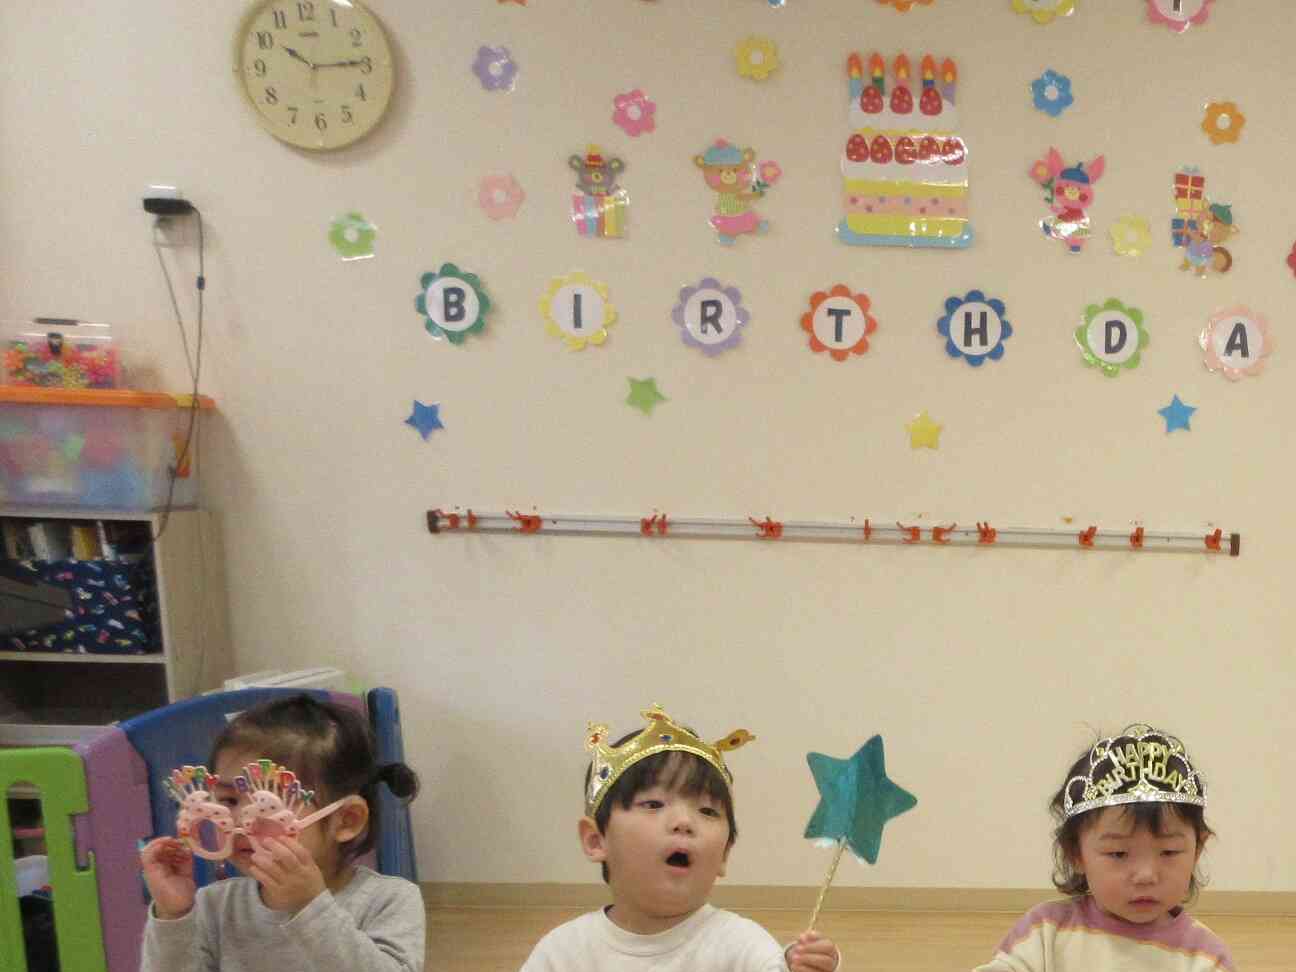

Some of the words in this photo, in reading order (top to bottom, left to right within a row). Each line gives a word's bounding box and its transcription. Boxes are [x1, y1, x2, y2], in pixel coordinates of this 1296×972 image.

[273, 10, 287, 29] 11
[297, 2, 314, 21] 12
[329, 8, 338, 28] 1
[256, 31, 274, 50] 10
[350, 28, 363, 47] 2
[254, 59, 266, 78] 9
[360, 56, 373, 74] 3
[264, 87, 278, 105] 8
[355, 83, 367, 101] 4
[288, 107, 298, 126] 7
[314, 113, 327, 131] 6
[341, 105, 352, 123] 5
[1108, 742, 1170, 768] HAPPY
[1097, 761, 1185, 795] BIRTHDAY
